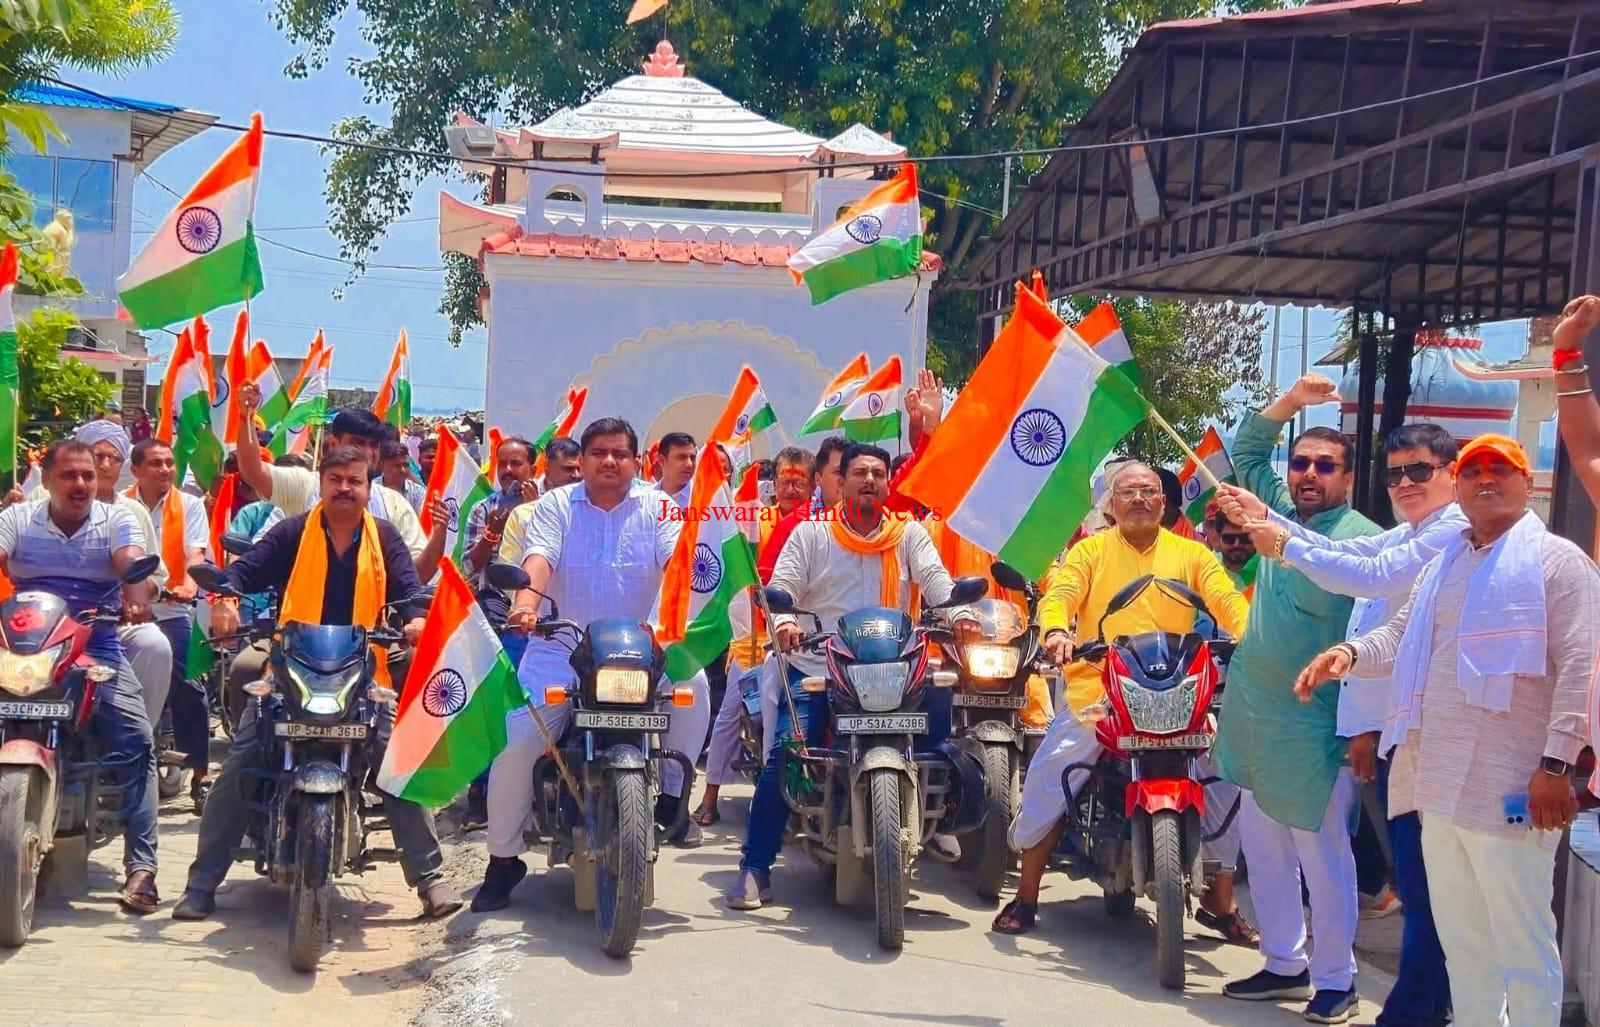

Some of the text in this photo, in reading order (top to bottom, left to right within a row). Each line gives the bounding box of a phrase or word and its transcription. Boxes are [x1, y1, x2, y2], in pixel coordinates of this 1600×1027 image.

[1149, 663, 1168, 671] TVS
[962, 695, 974, 706] UP
[589, 715, 666, 728] UP 53EE 3198
[849, 718, 925, 730] UP 53AZ 4386
[287, 724, 301, 736] UP
[337, 726, 365, 737] 3615
[1131, 735, 1143, 747] UP
